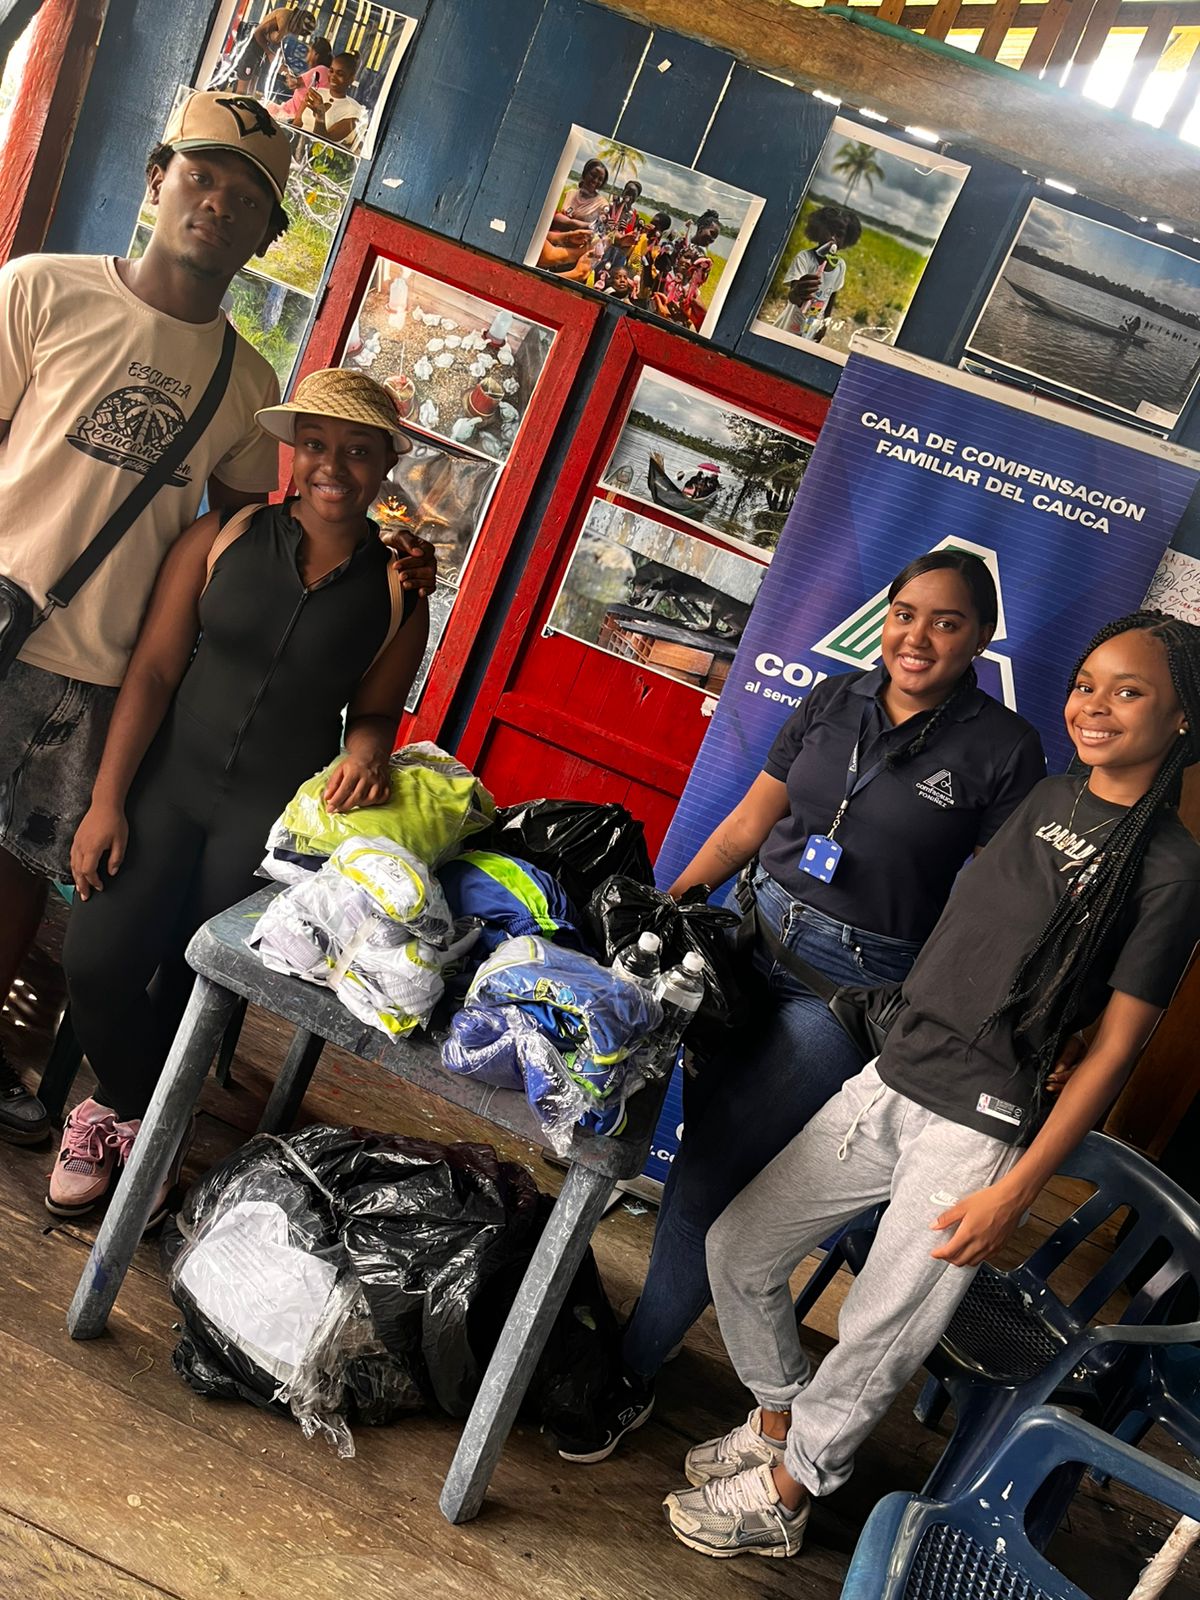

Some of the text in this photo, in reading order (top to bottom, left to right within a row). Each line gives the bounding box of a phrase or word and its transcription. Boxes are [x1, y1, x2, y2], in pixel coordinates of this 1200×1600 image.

[128, 361, 192, 399] ESCUELA
[861, 411, 1146, 522] CAJA DE COMPENSACIÓN
[875, 439, 1109, 534] FAMILIAR DEL CAUCA
[744, 681, 803, 709] al servi
[915, 782, 955, 805] comfacauca
[935, 1189, 960, 1206] NIKE
